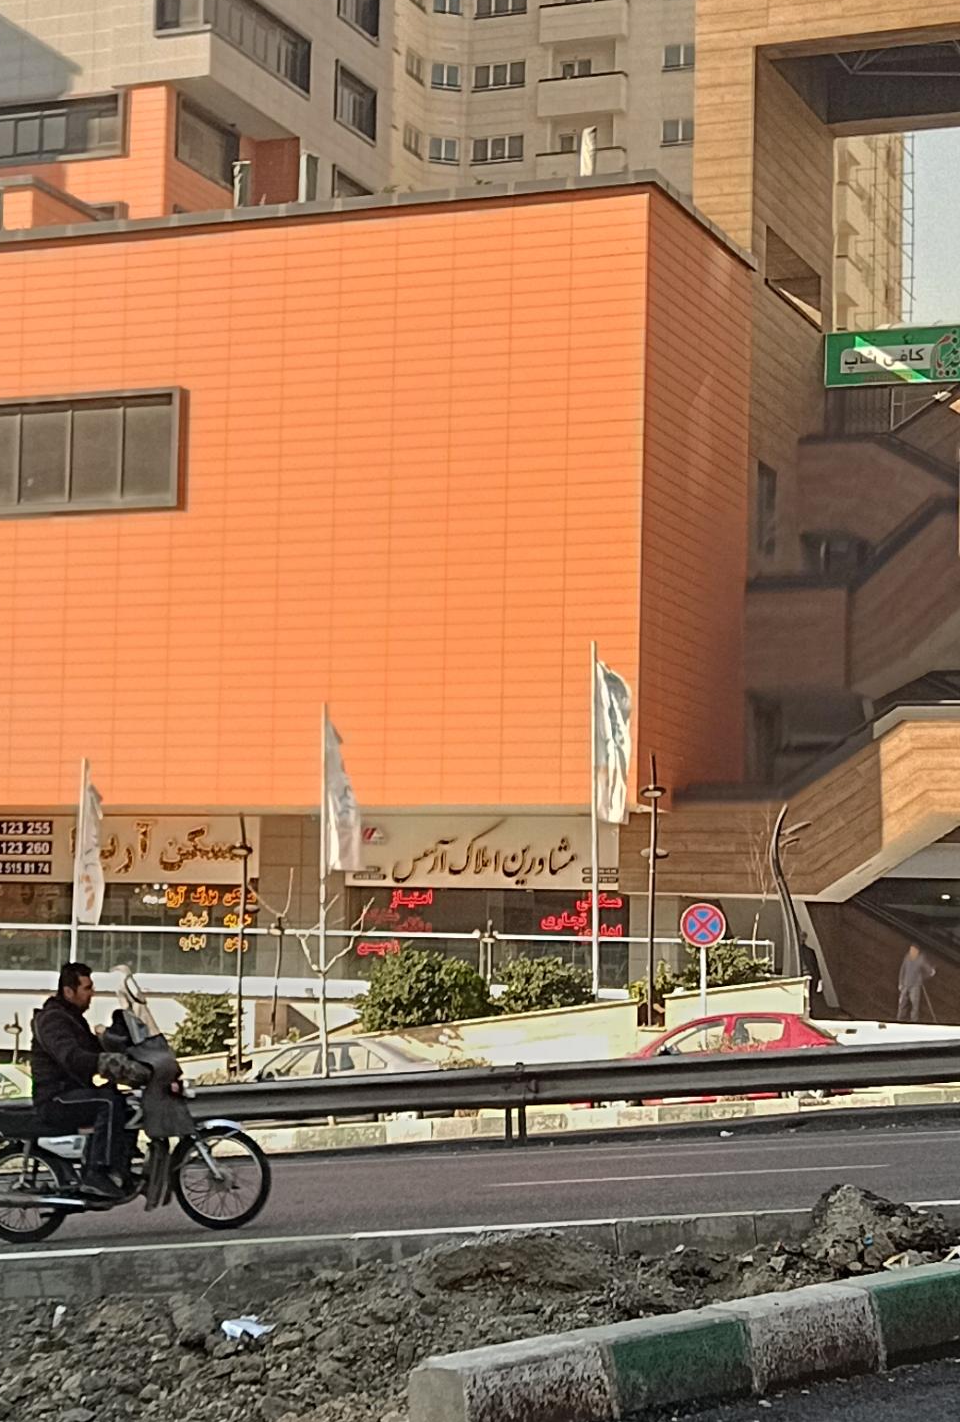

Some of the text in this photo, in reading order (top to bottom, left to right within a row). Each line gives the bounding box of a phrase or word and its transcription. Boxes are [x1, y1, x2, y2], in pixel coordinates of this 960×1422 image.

[844, 350, 878, 373] شاپ
[883, 348, 925, 368] کافی
[1, 822, 23, 833] 123
[27, 822, 50, 833] 255
[1, 842, 23, 854] 123
[26, 842, 50, 854] 260
[449, 816, 508, 876] املاک
[5, 862, 22, 874] 515
[24, 862, 35, 874] 81
[38, 862, 50, 874] 74
[502, 836, 579, 885] مشاورین
[390, 889, 433, 908] امتیاز
[576, 891, 623, 911] مسکنی
[540, 911, 587, 931] تجاری
